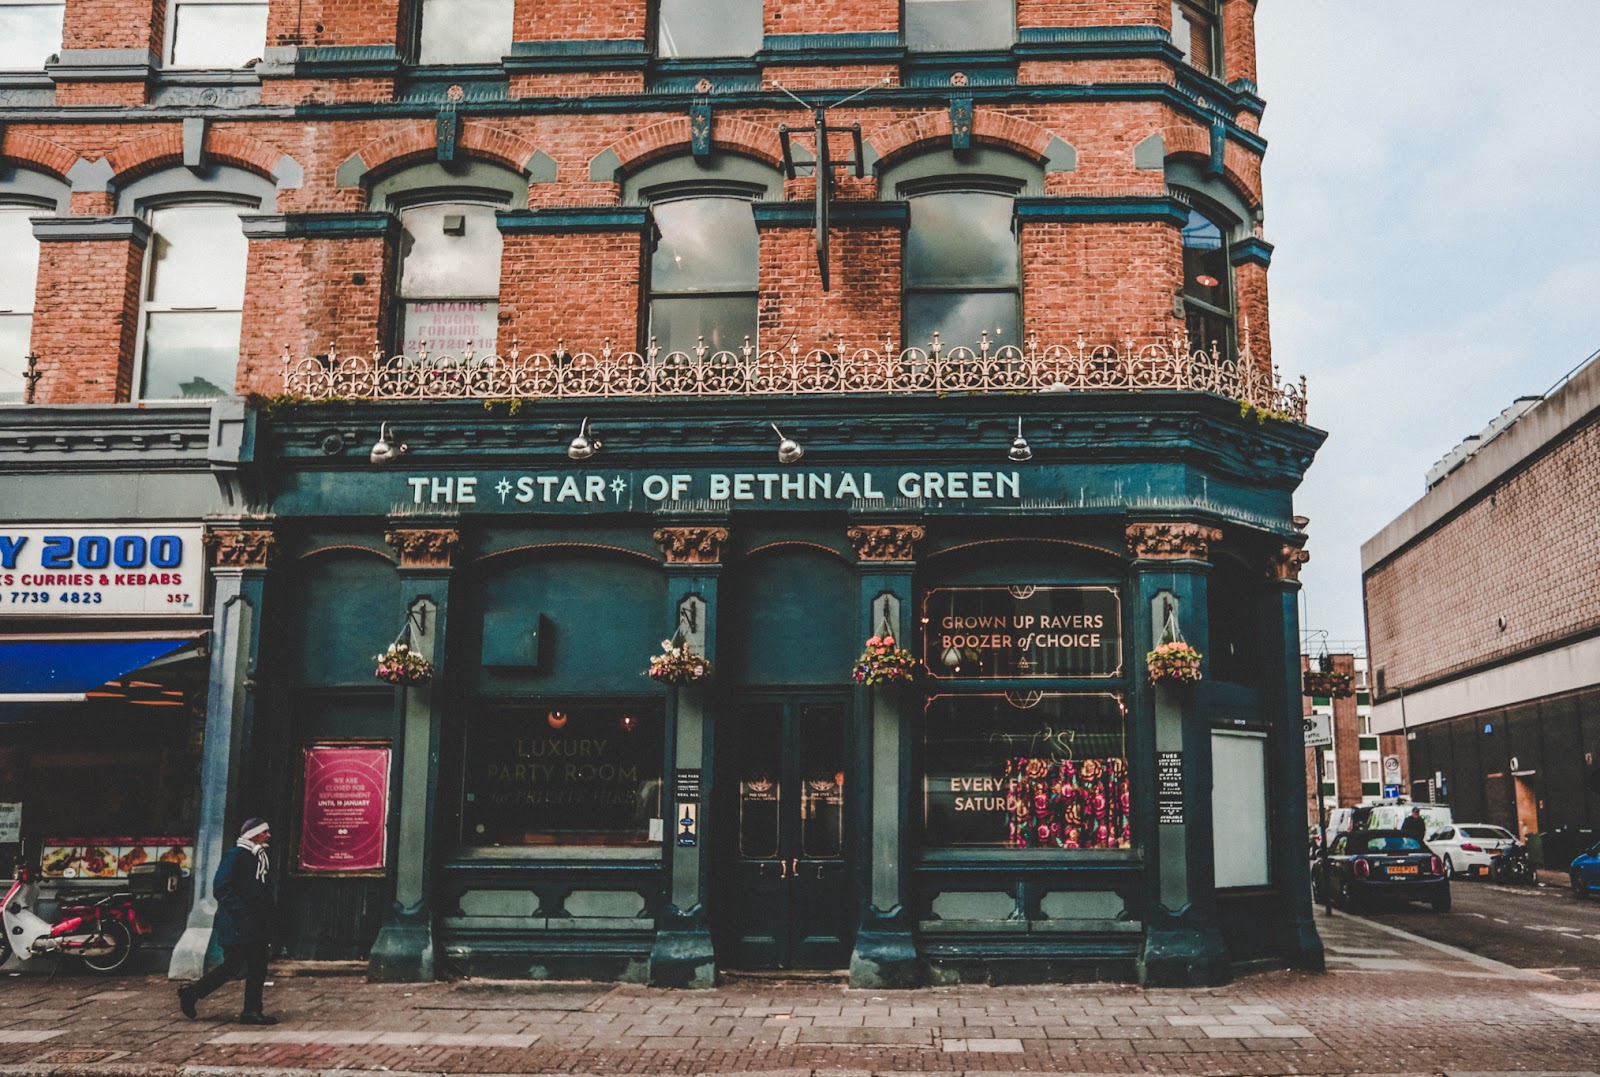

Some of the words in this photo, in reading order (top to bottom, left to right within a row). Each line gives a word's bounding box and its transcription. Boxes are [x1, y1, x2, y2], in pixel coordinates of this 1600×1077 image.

[415, 302, 488, 313] KARAOKE
[433, 314, 474, 325] ROOM
[418, 325, 445, 336] FOR
[408, 477, 477, 504] THE
[514, 475, 606, 503] STAR
[643, 474, 692, 501] OF
[710, 472, 884, 500] BETHNAL
[899, 472, 1020, 498] GREEN
[41, 535, 183, 569] 2000
[21, 574, 94, 586] CURRIES
[98, 574, 109, 586] &
[115, 573, 182, 586] KEBABS
[11, 592, 50, 604] 7739
[60, 592, 102, 604] 4823
[167, 594, 189, 603] 357
[942, 616, 1006, 629] GROWN
[1013, 616, 1034, 629] UP
[1040, 615, 1103, 629] RAVERS
[942, 635, 1012, 648] BOOZER
[1017, 633, 1035, 651] of
[1035, 634, 1100, 648] CHOICE
[517, 739, 608, 757] LUXURY
[487, 763, 554, 781] PARTY
[564, 763, 638, 781] ROOM
[951, 778, 1003, 792] EVERY
[954, 797, 1019, 811] SATURD
